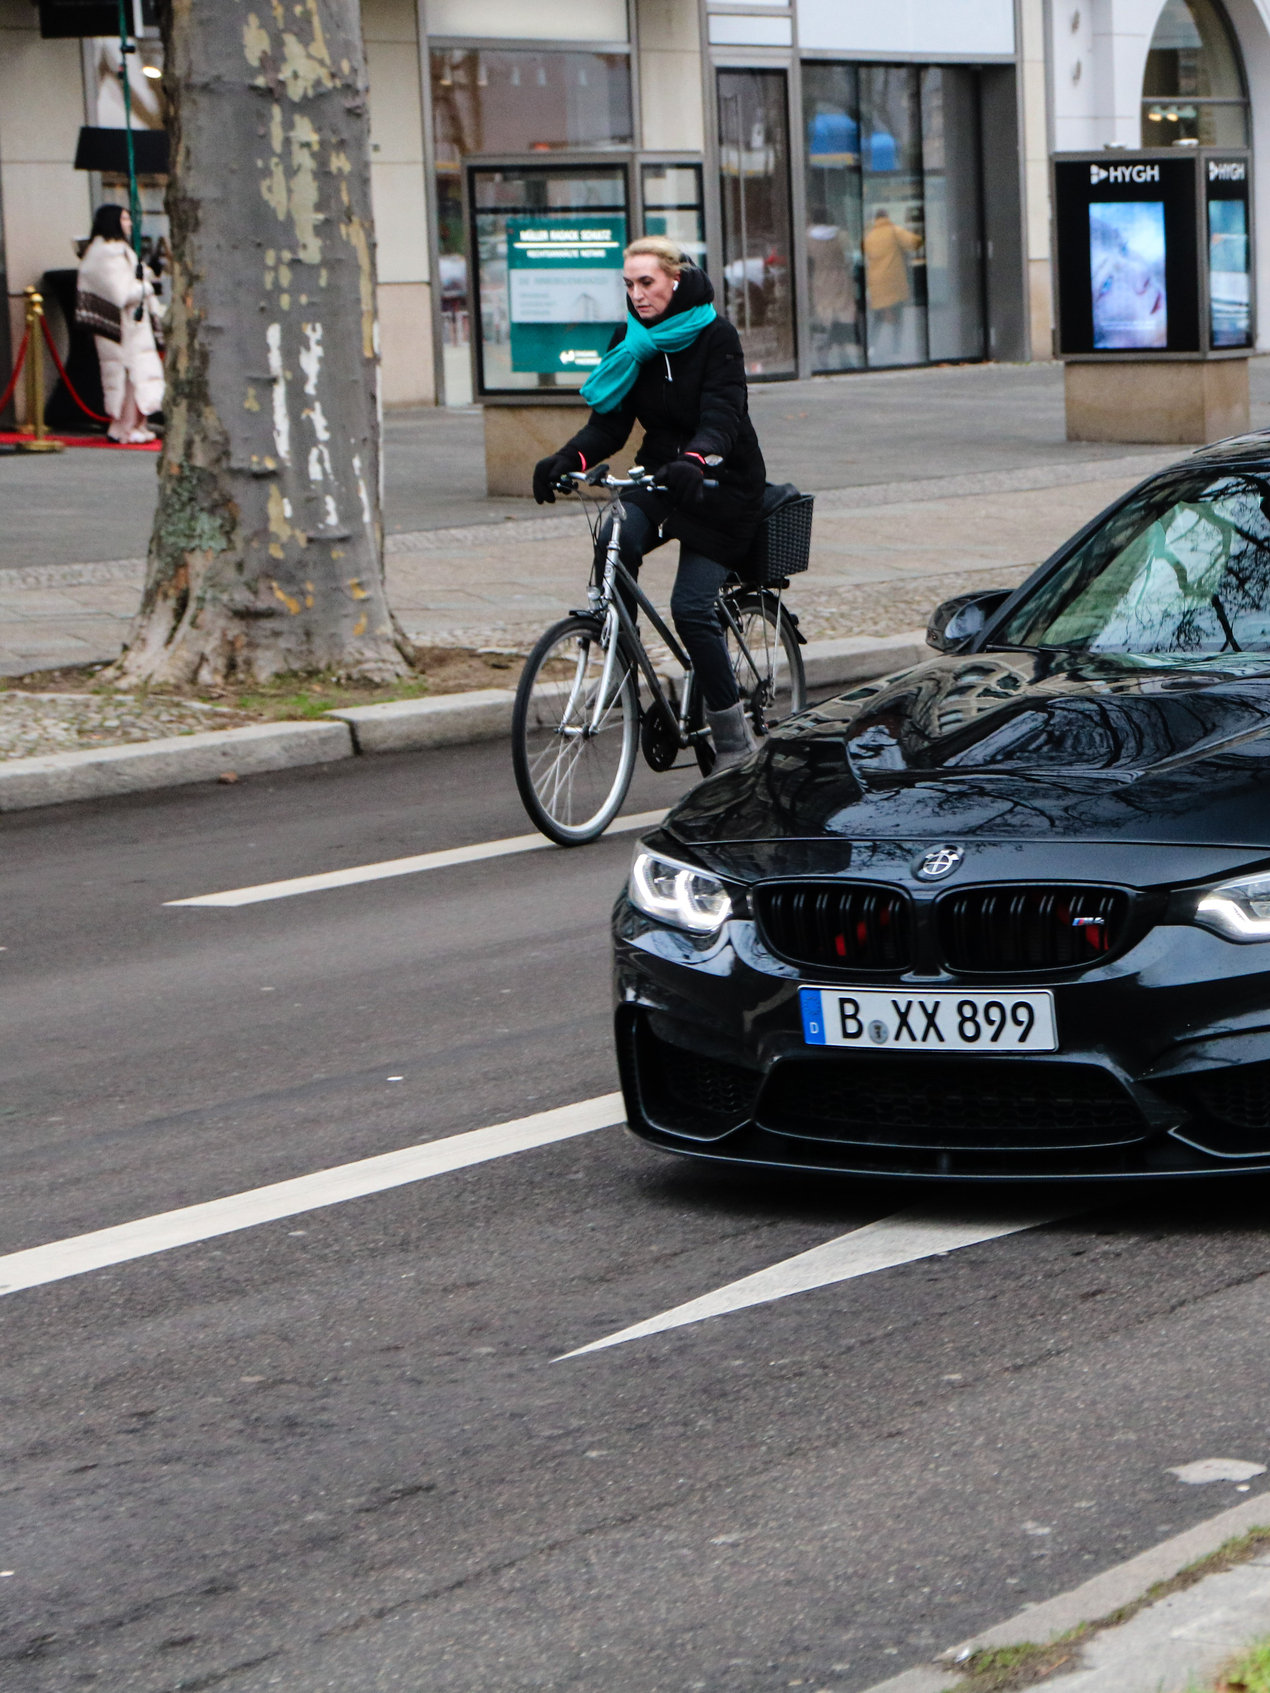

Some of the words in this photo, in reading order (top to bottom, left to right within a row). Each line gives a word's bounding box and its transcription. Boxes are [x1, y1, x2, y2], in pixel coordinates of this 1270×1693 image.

[1109, 164, 1160, 183] HYGH
[1218, 162, 1245, 180] HYGH
[811, 1022, 818, 1034] D
[838, 998, 864, 1039] B
[891, 999, 945, 1042] XX
[956, 999, 1035, 1043] 899
